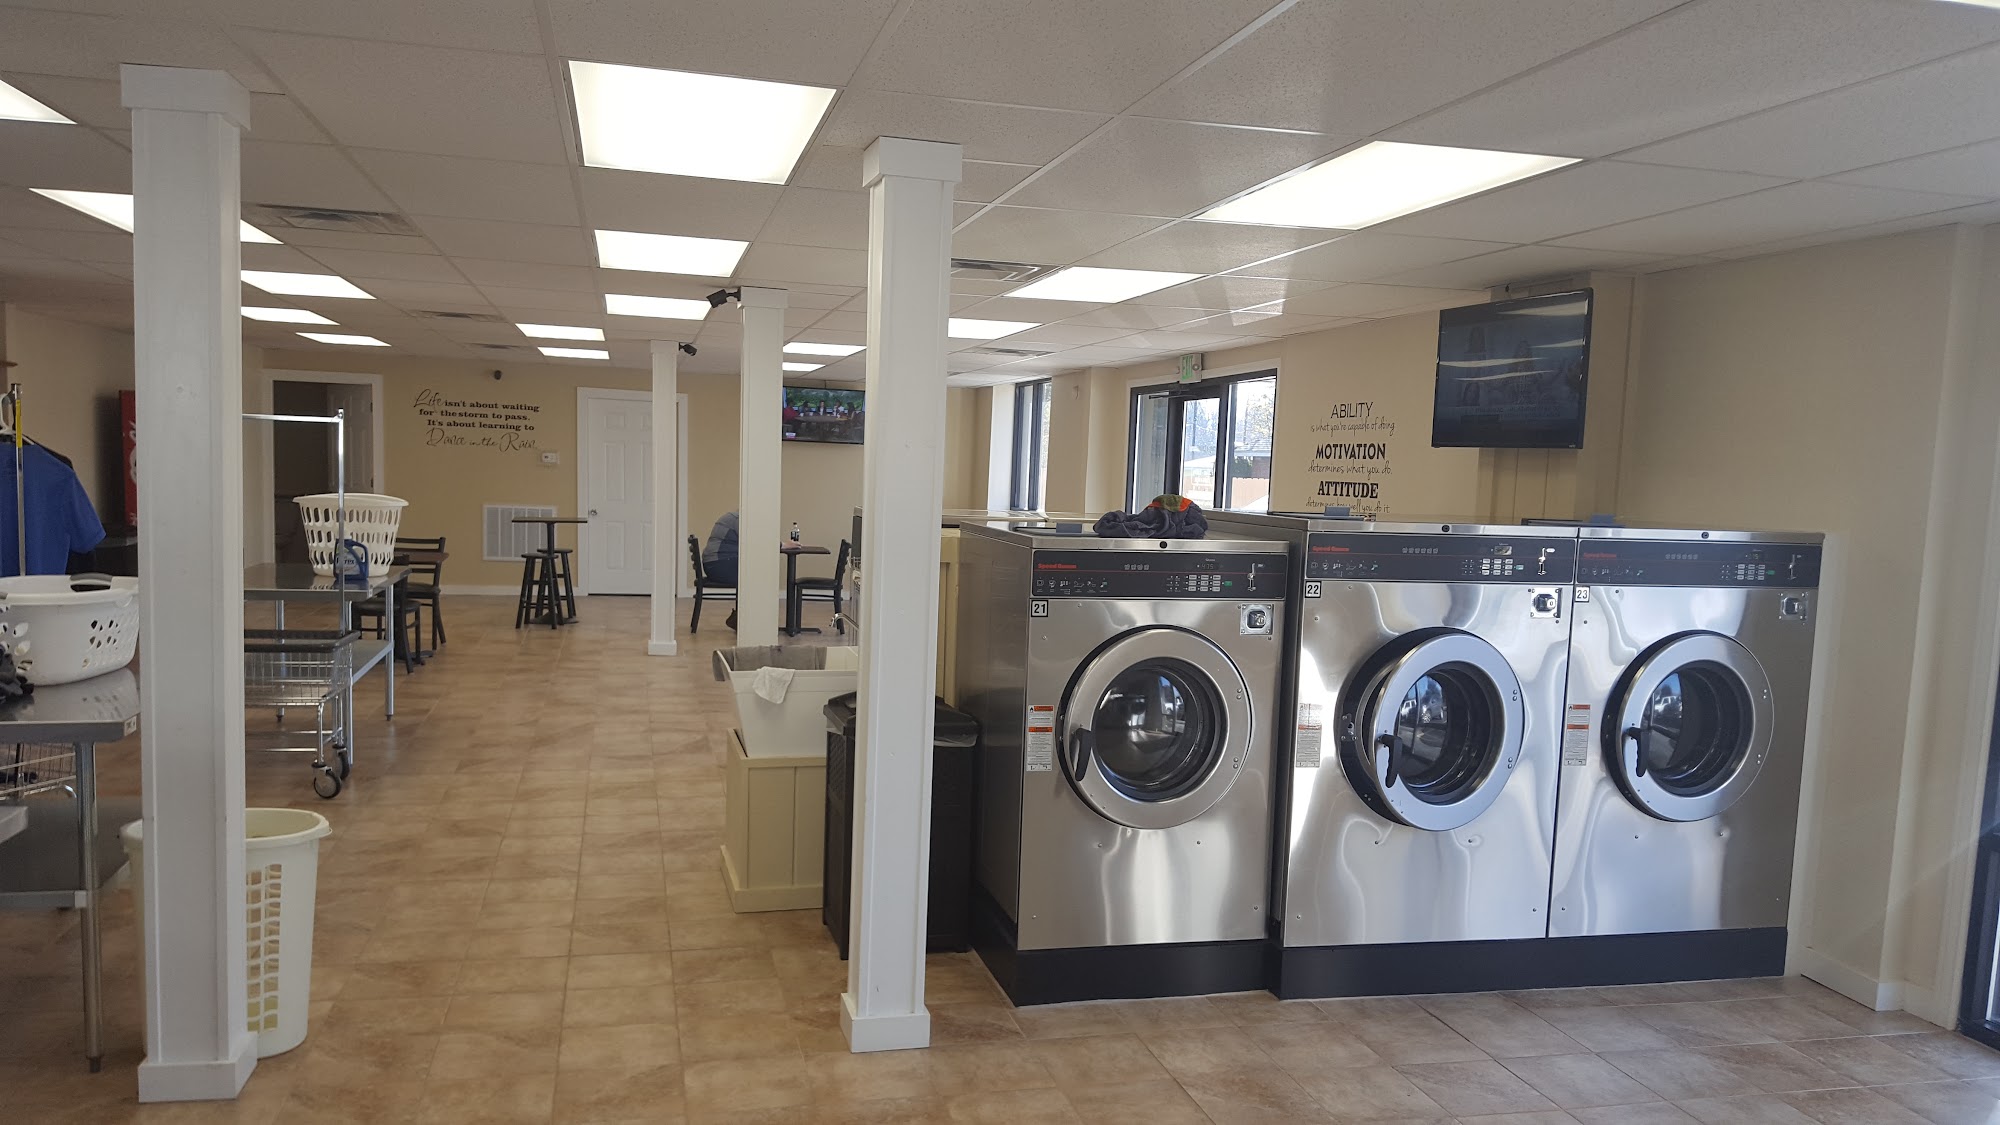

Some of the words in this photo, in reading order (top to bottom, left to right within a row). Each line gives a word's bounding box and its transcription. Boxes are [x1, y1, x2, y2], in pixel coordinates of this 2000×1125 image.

[414, 389, 443, 412] Life
[444, 400, 467, 408] isn't
[469, 401, 499, 409] about
[501, 404, 540, 413] waiting
[419, 408, 435, 417] for
[440, 409, 457, 417] the
[458, 411, 489, 419] storm
[492, 412, 503, 420] to
[1330, 402, 1374, 418] ABILITY
[427, 419, 444, 427] It's
[446, 420, 476, 428] about
[479, 421, 521, 432] learning
[524, 423, 535, 431] to
[425, 427, 467, 447] Dance
[1315, 442, 1386, 460] MOTIVATION
[1308, 459, 1344, 473] determines
[1346, 459, 1366, 474] what
[1366, 465, 1380, 480] you
[1317, 480, 1379, 499] ATTITUDE
[1307, 584, 1319, 595] 22
[1576, 589, 1588, 599] 23
[1034, 603, 1046, 615] 21
